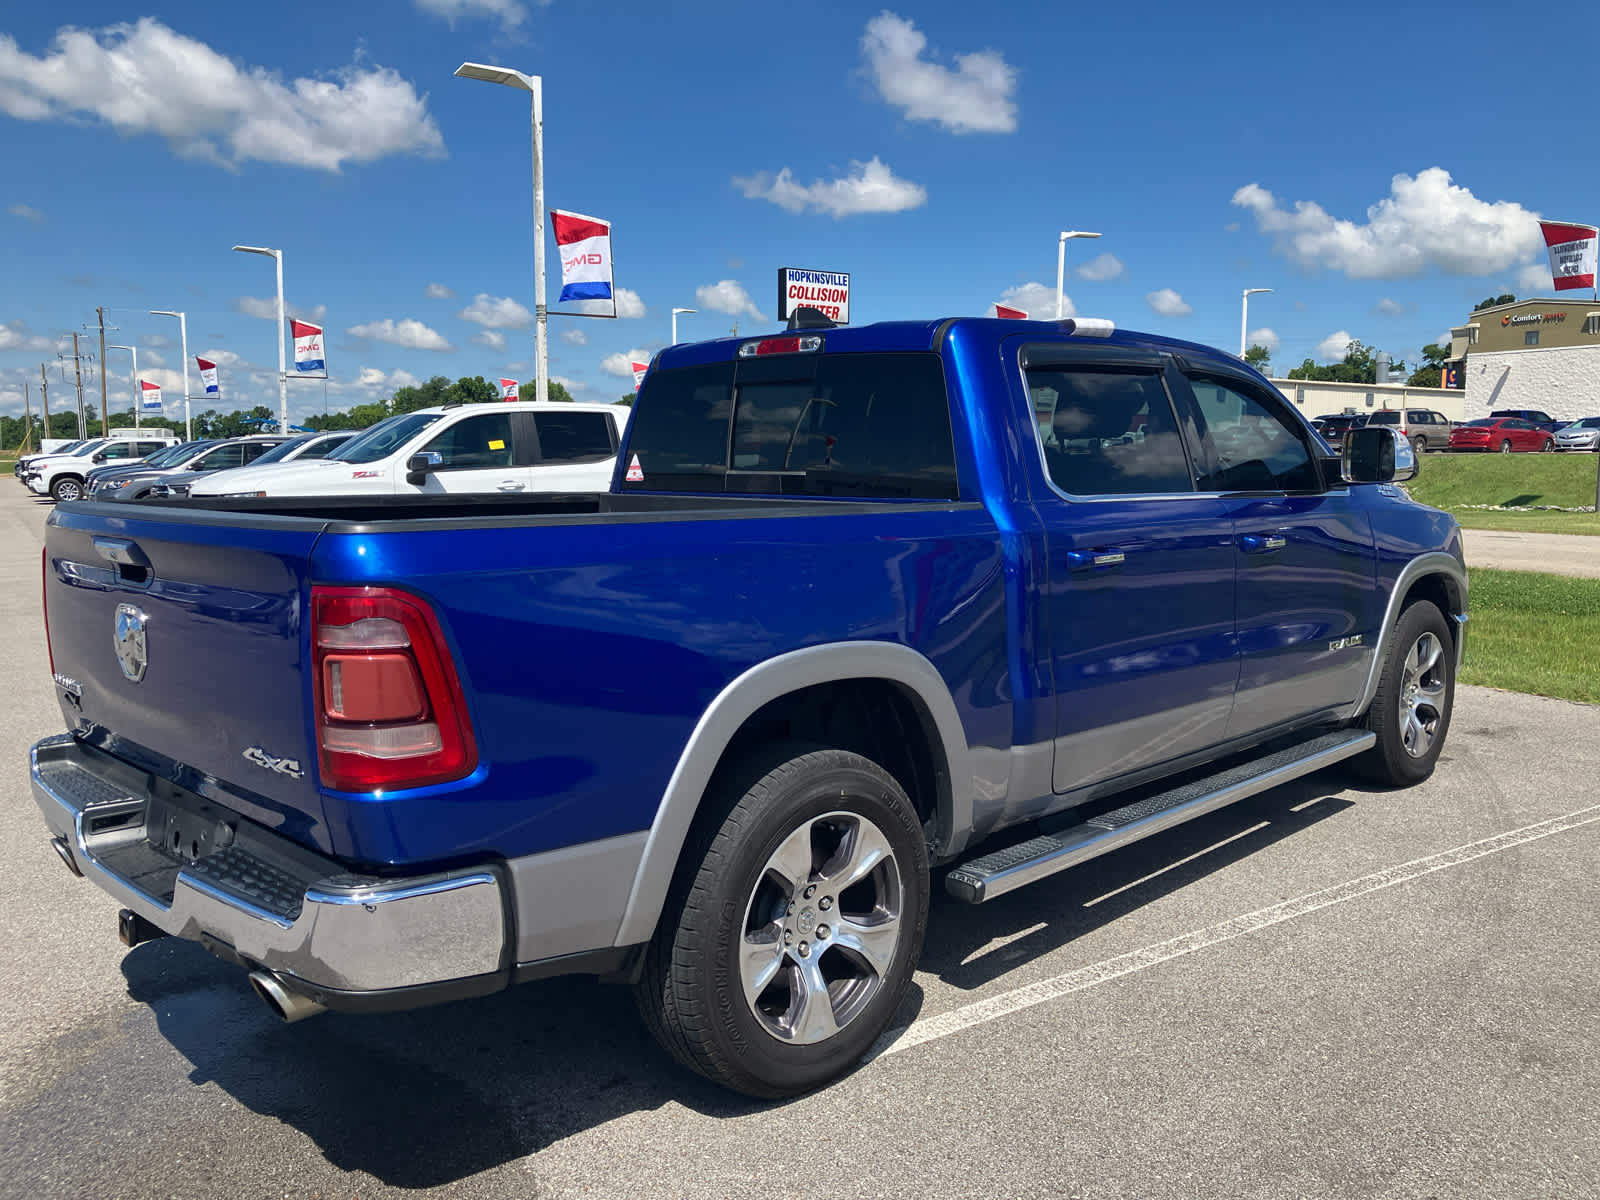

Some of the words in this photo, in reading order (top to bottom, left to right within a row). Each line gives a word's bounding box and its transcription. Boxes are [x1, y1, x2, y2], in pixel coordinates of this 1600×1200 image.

[788, 270, 848, 287] HOPKINSVILLE
[788, 285, 848, 303] COLLISION
[797, 303, 841, 320] TER
